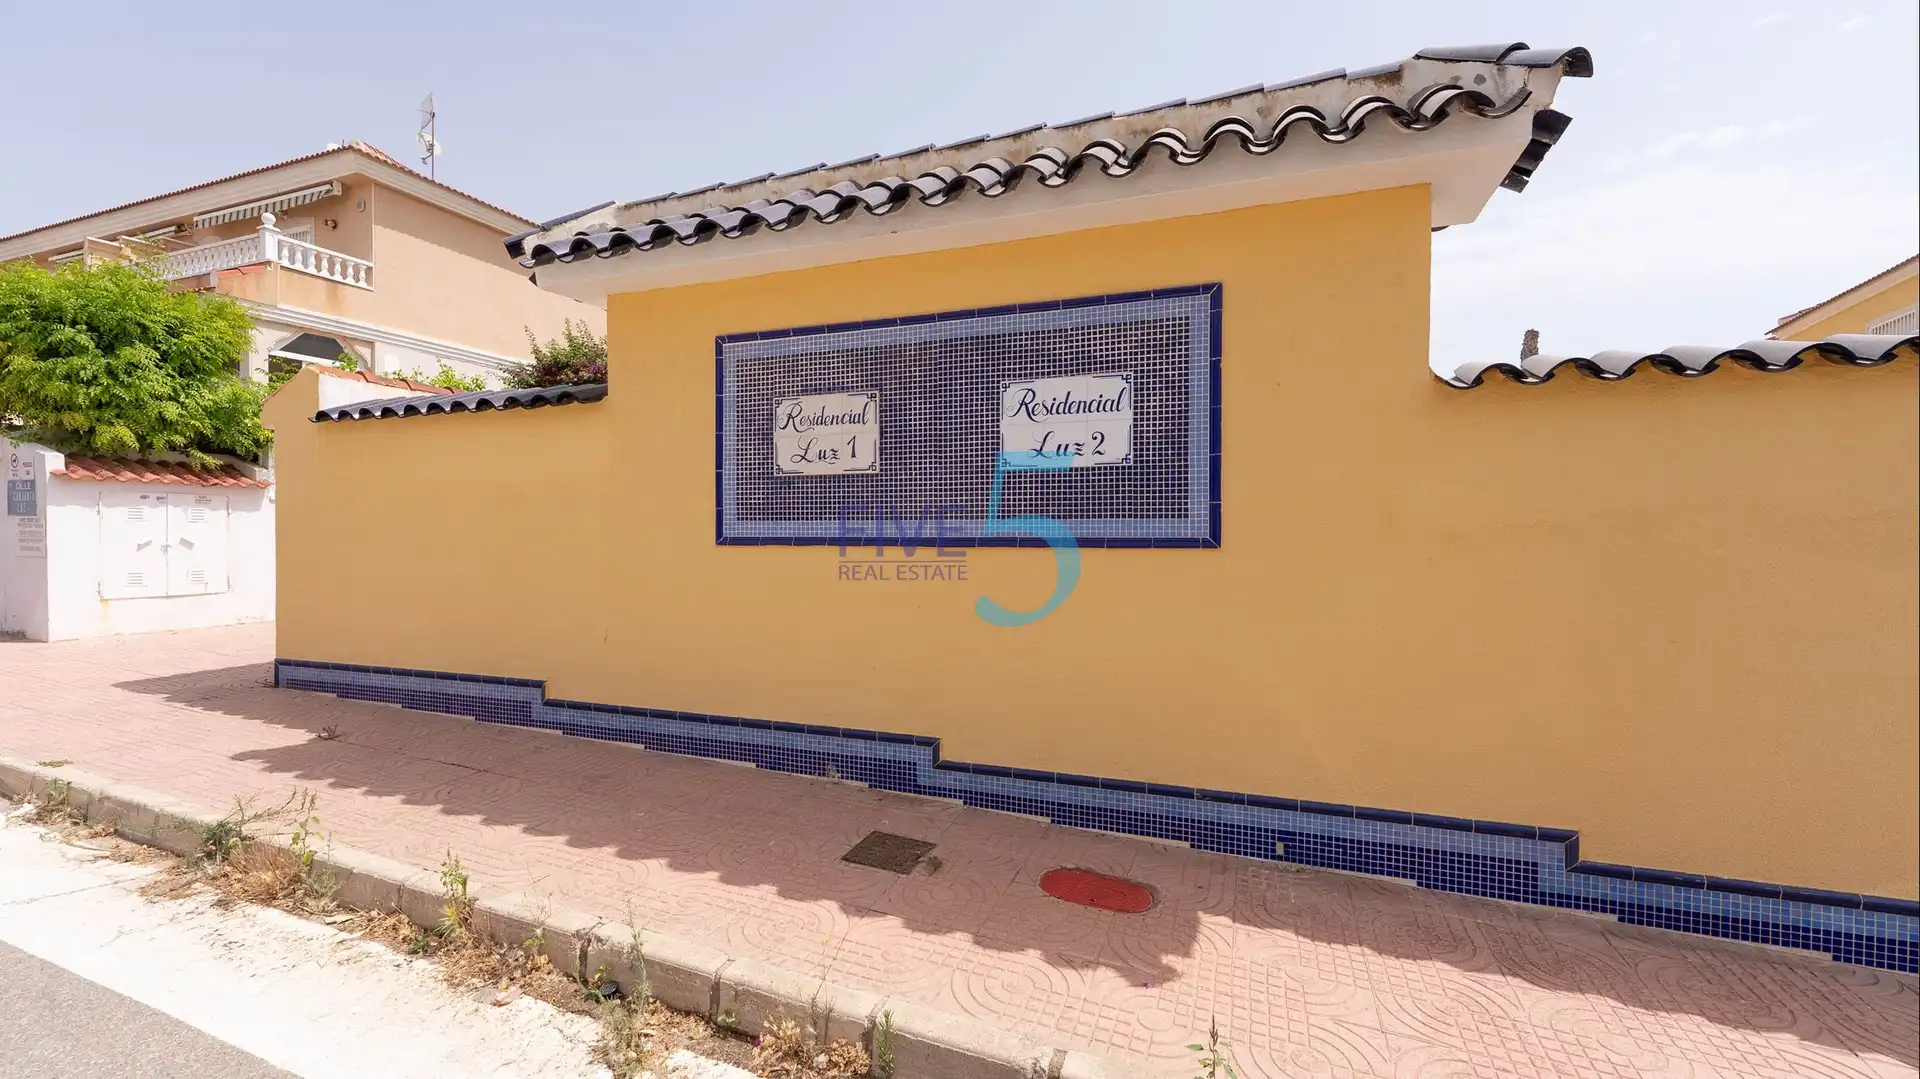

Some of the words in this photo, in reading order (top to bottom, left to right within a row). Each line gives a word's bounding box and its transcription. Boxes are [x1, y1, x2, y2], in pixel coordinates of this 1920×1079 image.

[778, 401, 871, 433] Residencial
[1005, 387, 1128, 423] Residencial
[790, 435, 841, 465] Luz
[846, 435, 857, 459] 1
[1027, 430, 1086, 459] Luz
[1091, 430, 1106, 456] 2
